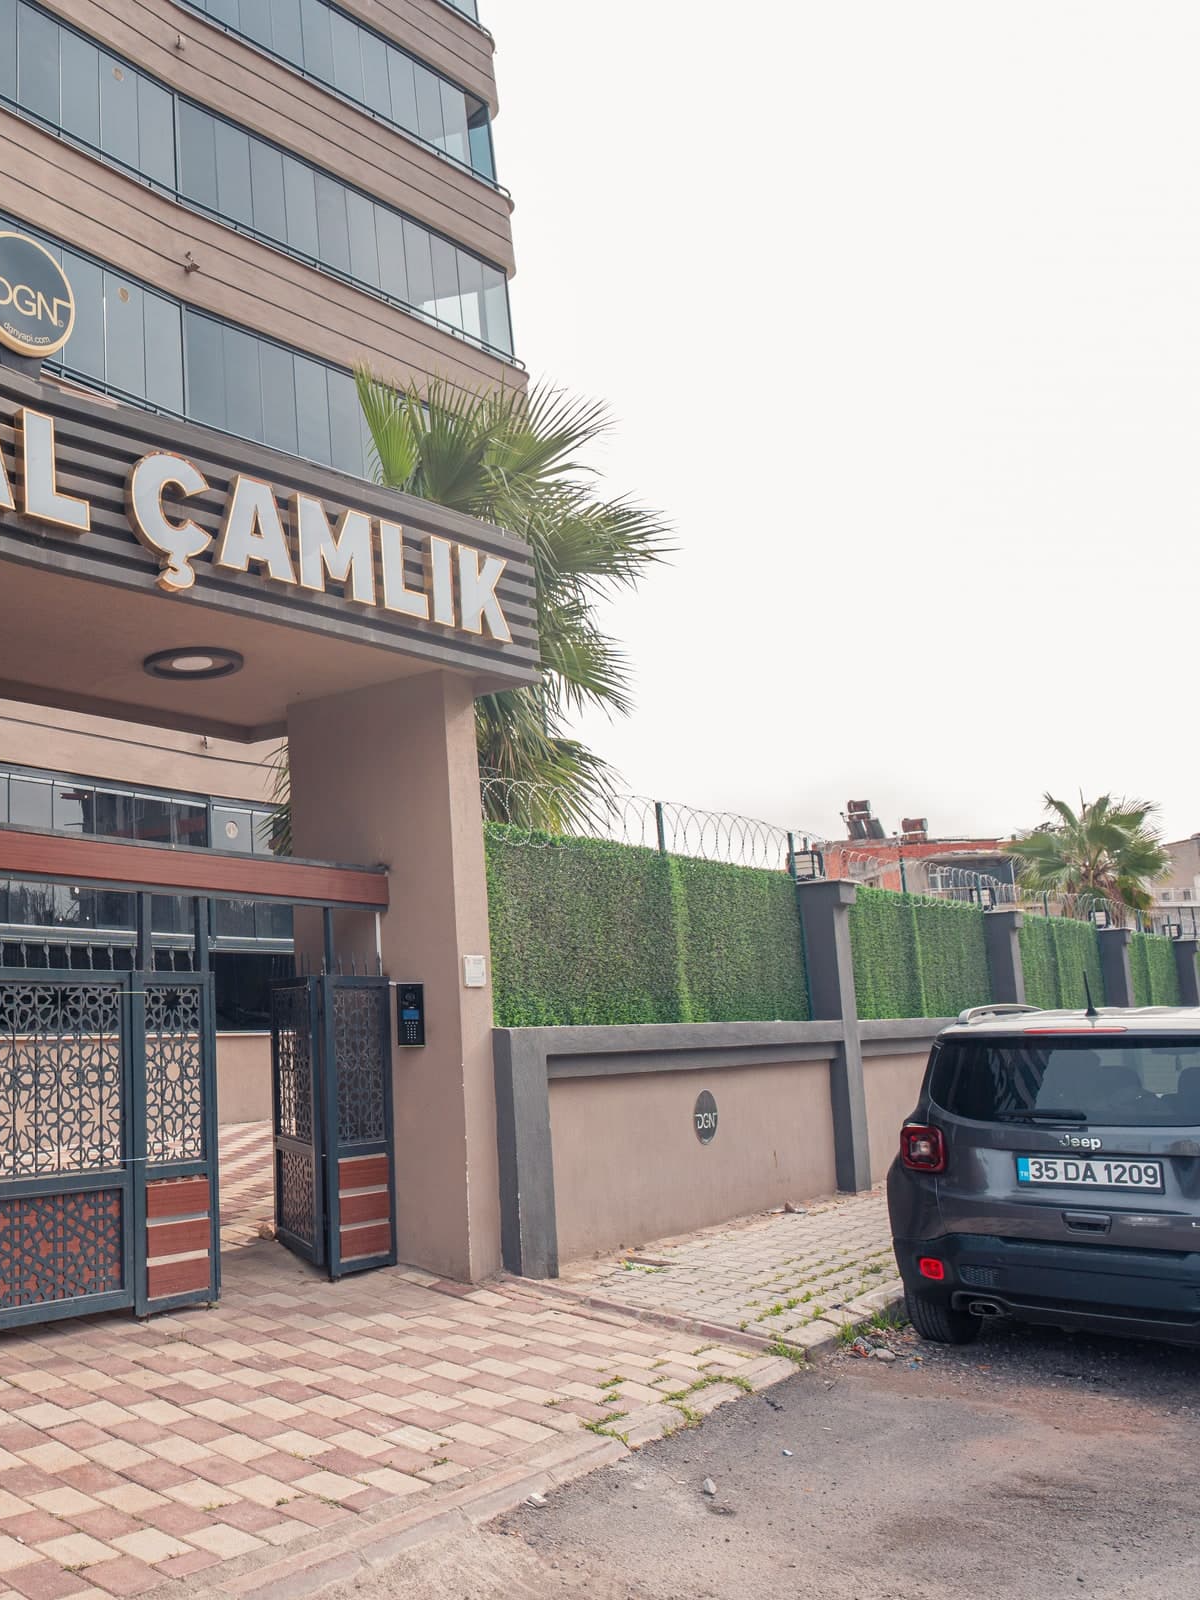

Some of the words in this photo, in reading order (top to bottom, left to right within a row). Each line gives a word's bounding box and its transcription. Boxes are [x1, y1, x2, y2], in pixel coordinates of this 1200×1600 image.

[3, 321, 51, 344] dgnyapi.com
[124, 450, 514, 643] ÇAMLIK
[696, 1112, 717, 1129] DGN
[1060, 1134, 1102, 1151] Jeep
[1030, 1160, 1058, 1180] 35
[1063, 1161, 1098, 1183] DA
[1104, 1163, 1158, 1185] 1209
